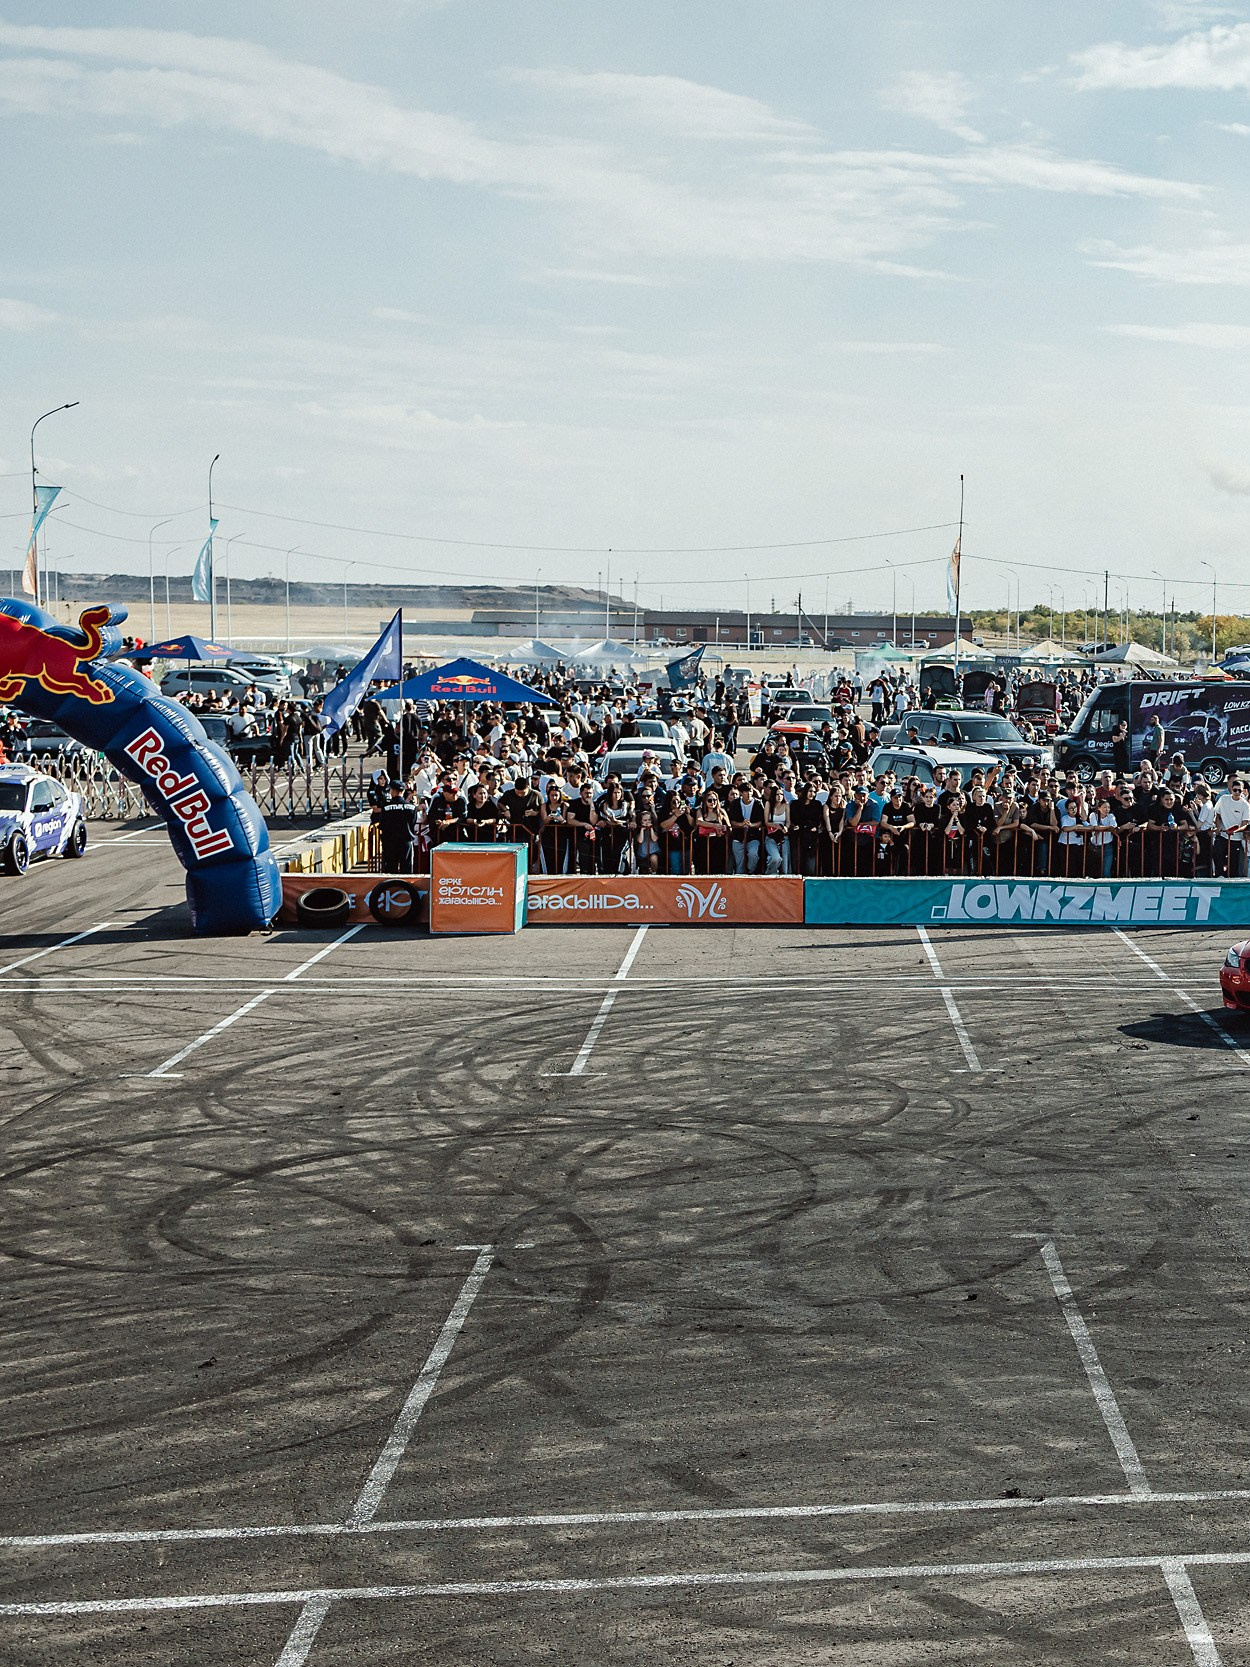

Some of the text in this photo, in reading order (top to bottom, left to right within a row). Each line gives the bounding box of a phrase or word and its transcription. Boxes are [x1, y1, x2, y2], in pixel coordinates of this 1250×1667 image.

[430, 684, 497, 694] Red Bull
[1140, 688, 1206, 709] DRIFT
[1223, 700, 1250, 710] LOW KZ
[1096, 740, 1114, 750] regio
[123, 726, 199, 800] Red
[170, 788, 234, 860] Bull
[42, 819, 61, 835] region
